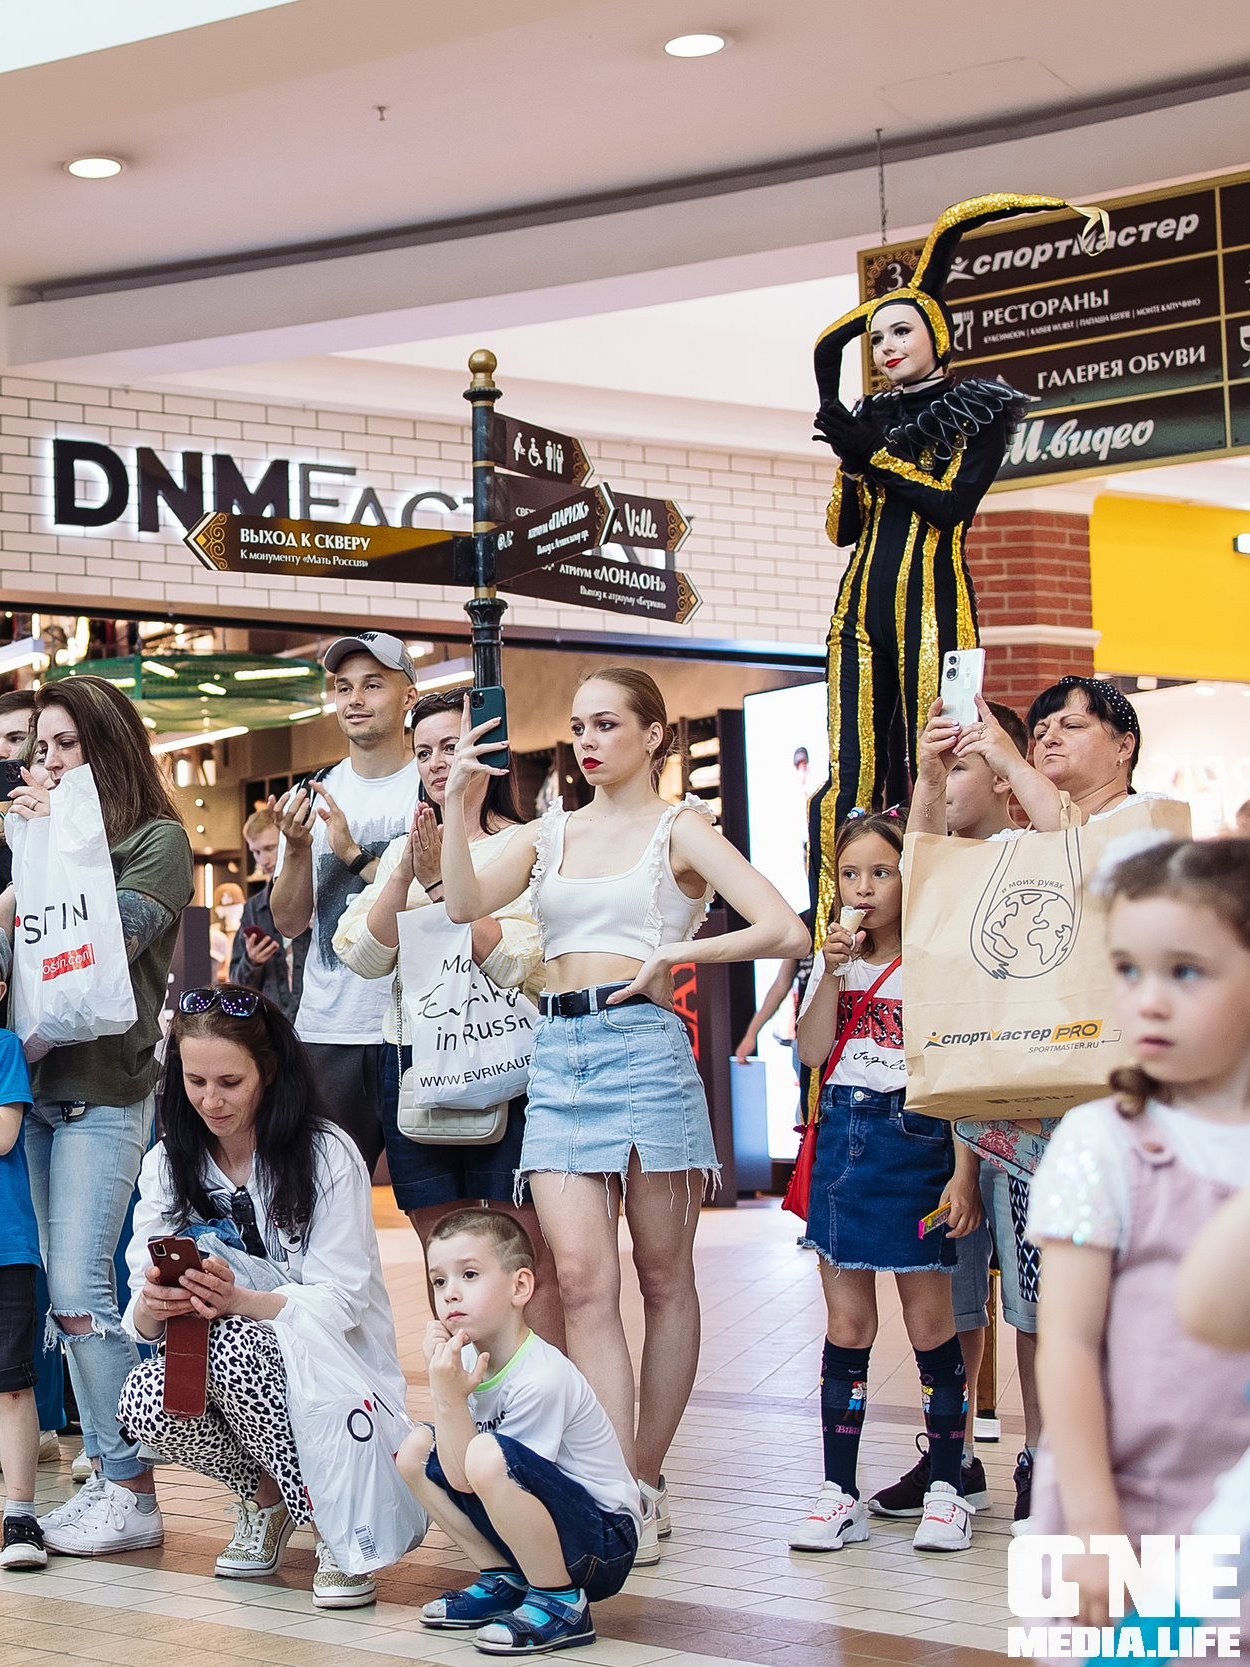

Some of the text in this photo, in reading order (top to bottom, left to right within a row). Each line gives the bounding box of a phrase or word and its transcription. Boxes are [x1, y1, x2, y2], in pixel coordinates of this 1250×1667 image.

[886, 262, 904, 292] 3
[982, 288, 1110, 328] РЕСТОРАНЫ
[1037, 345, 1206, 390] ГАЛЕРЕЯ ОБУВИ
[624, 502, 659, 539] Ville
[240, 528, 371, 552] ВЫХОД К СКВЕРУ
[240, 549, 369, 568] К монументу «Мать Россия»
[559, 563, 667, 593] АТРИУМ «ЛОНДОН»
[1008, 878, 1035, 889] моих
[1037, 879, 1064, 890] руках
[435, 1025, 458, 1051] in
[1055, 1022, 1099, 1040] PRO
[1028, 1040, 1100, 1054] SPORTMASTER.RU
